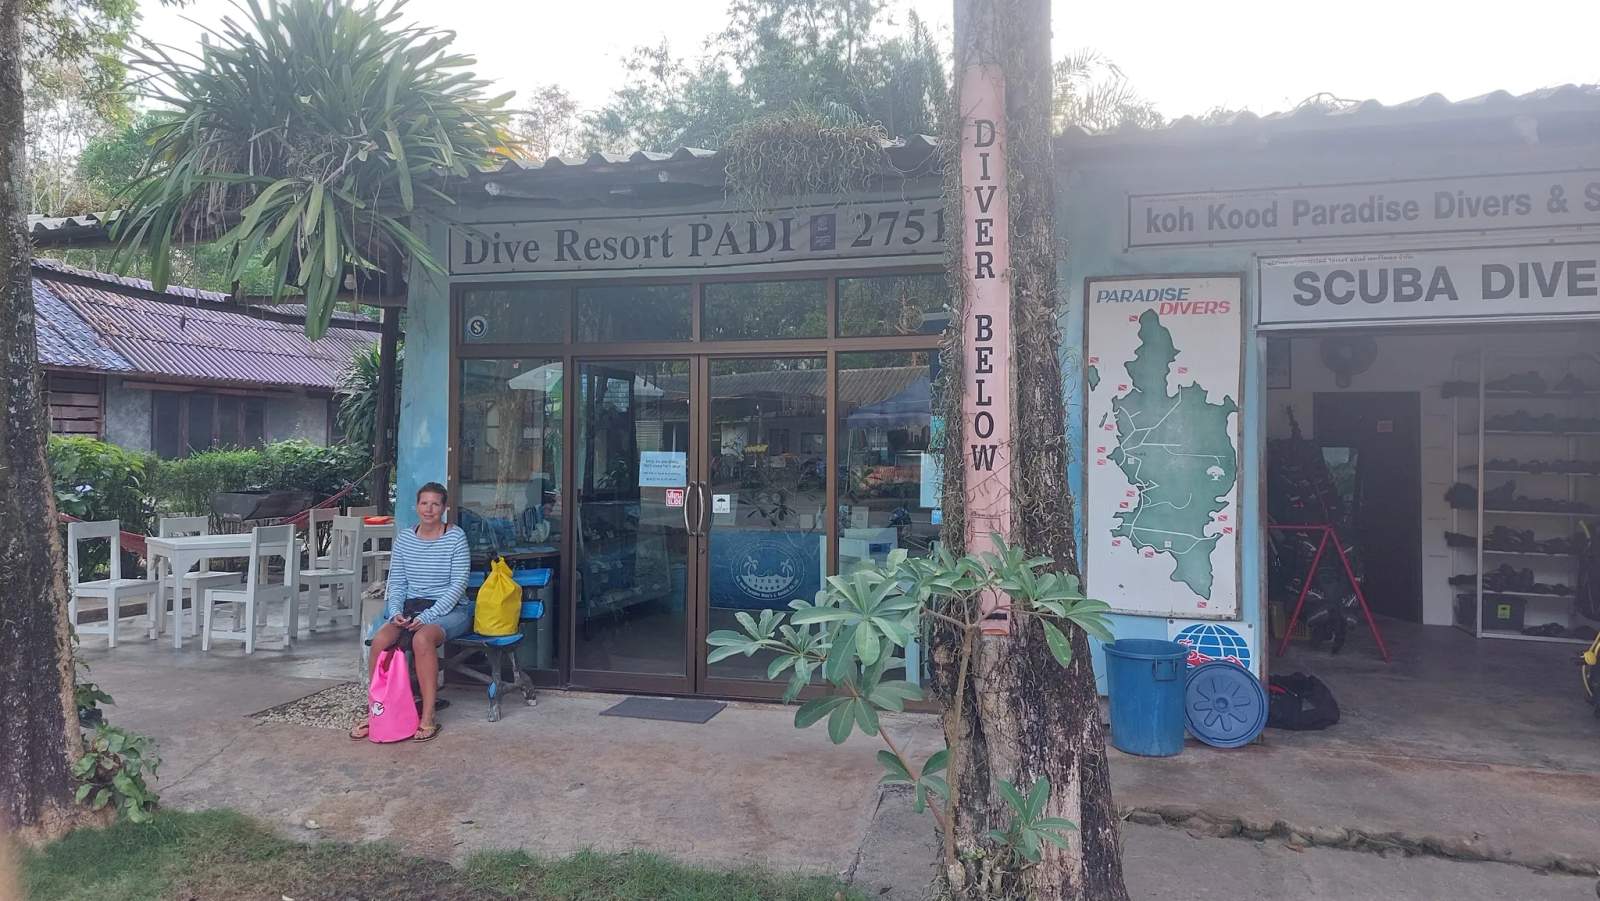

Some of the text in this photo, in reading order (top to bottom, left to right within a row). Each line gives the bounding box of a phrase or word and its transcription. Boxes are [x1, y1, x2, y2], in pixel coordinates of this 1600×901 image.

[1146, 206, 1194, 234] koh
[1208, 200, 1278, 231] Kood
[1292, 194, 1419, 227] Paradise
[1434, 190, 1532, 219] Divers
[1546, 184, 1568, 213] &
[462, 231, 540, 265] Dive
[553, 226, 674, 262] Resort
[688, 218, 796, 257] PADI
[971, 119, 998, 471] DIVER BELOW
[1096, 287, 1191, 303] PARADISE
[1293, 260, 1598, 306] SCUBA DIVE
[1159, 301, 1231, 316] DIVERS
